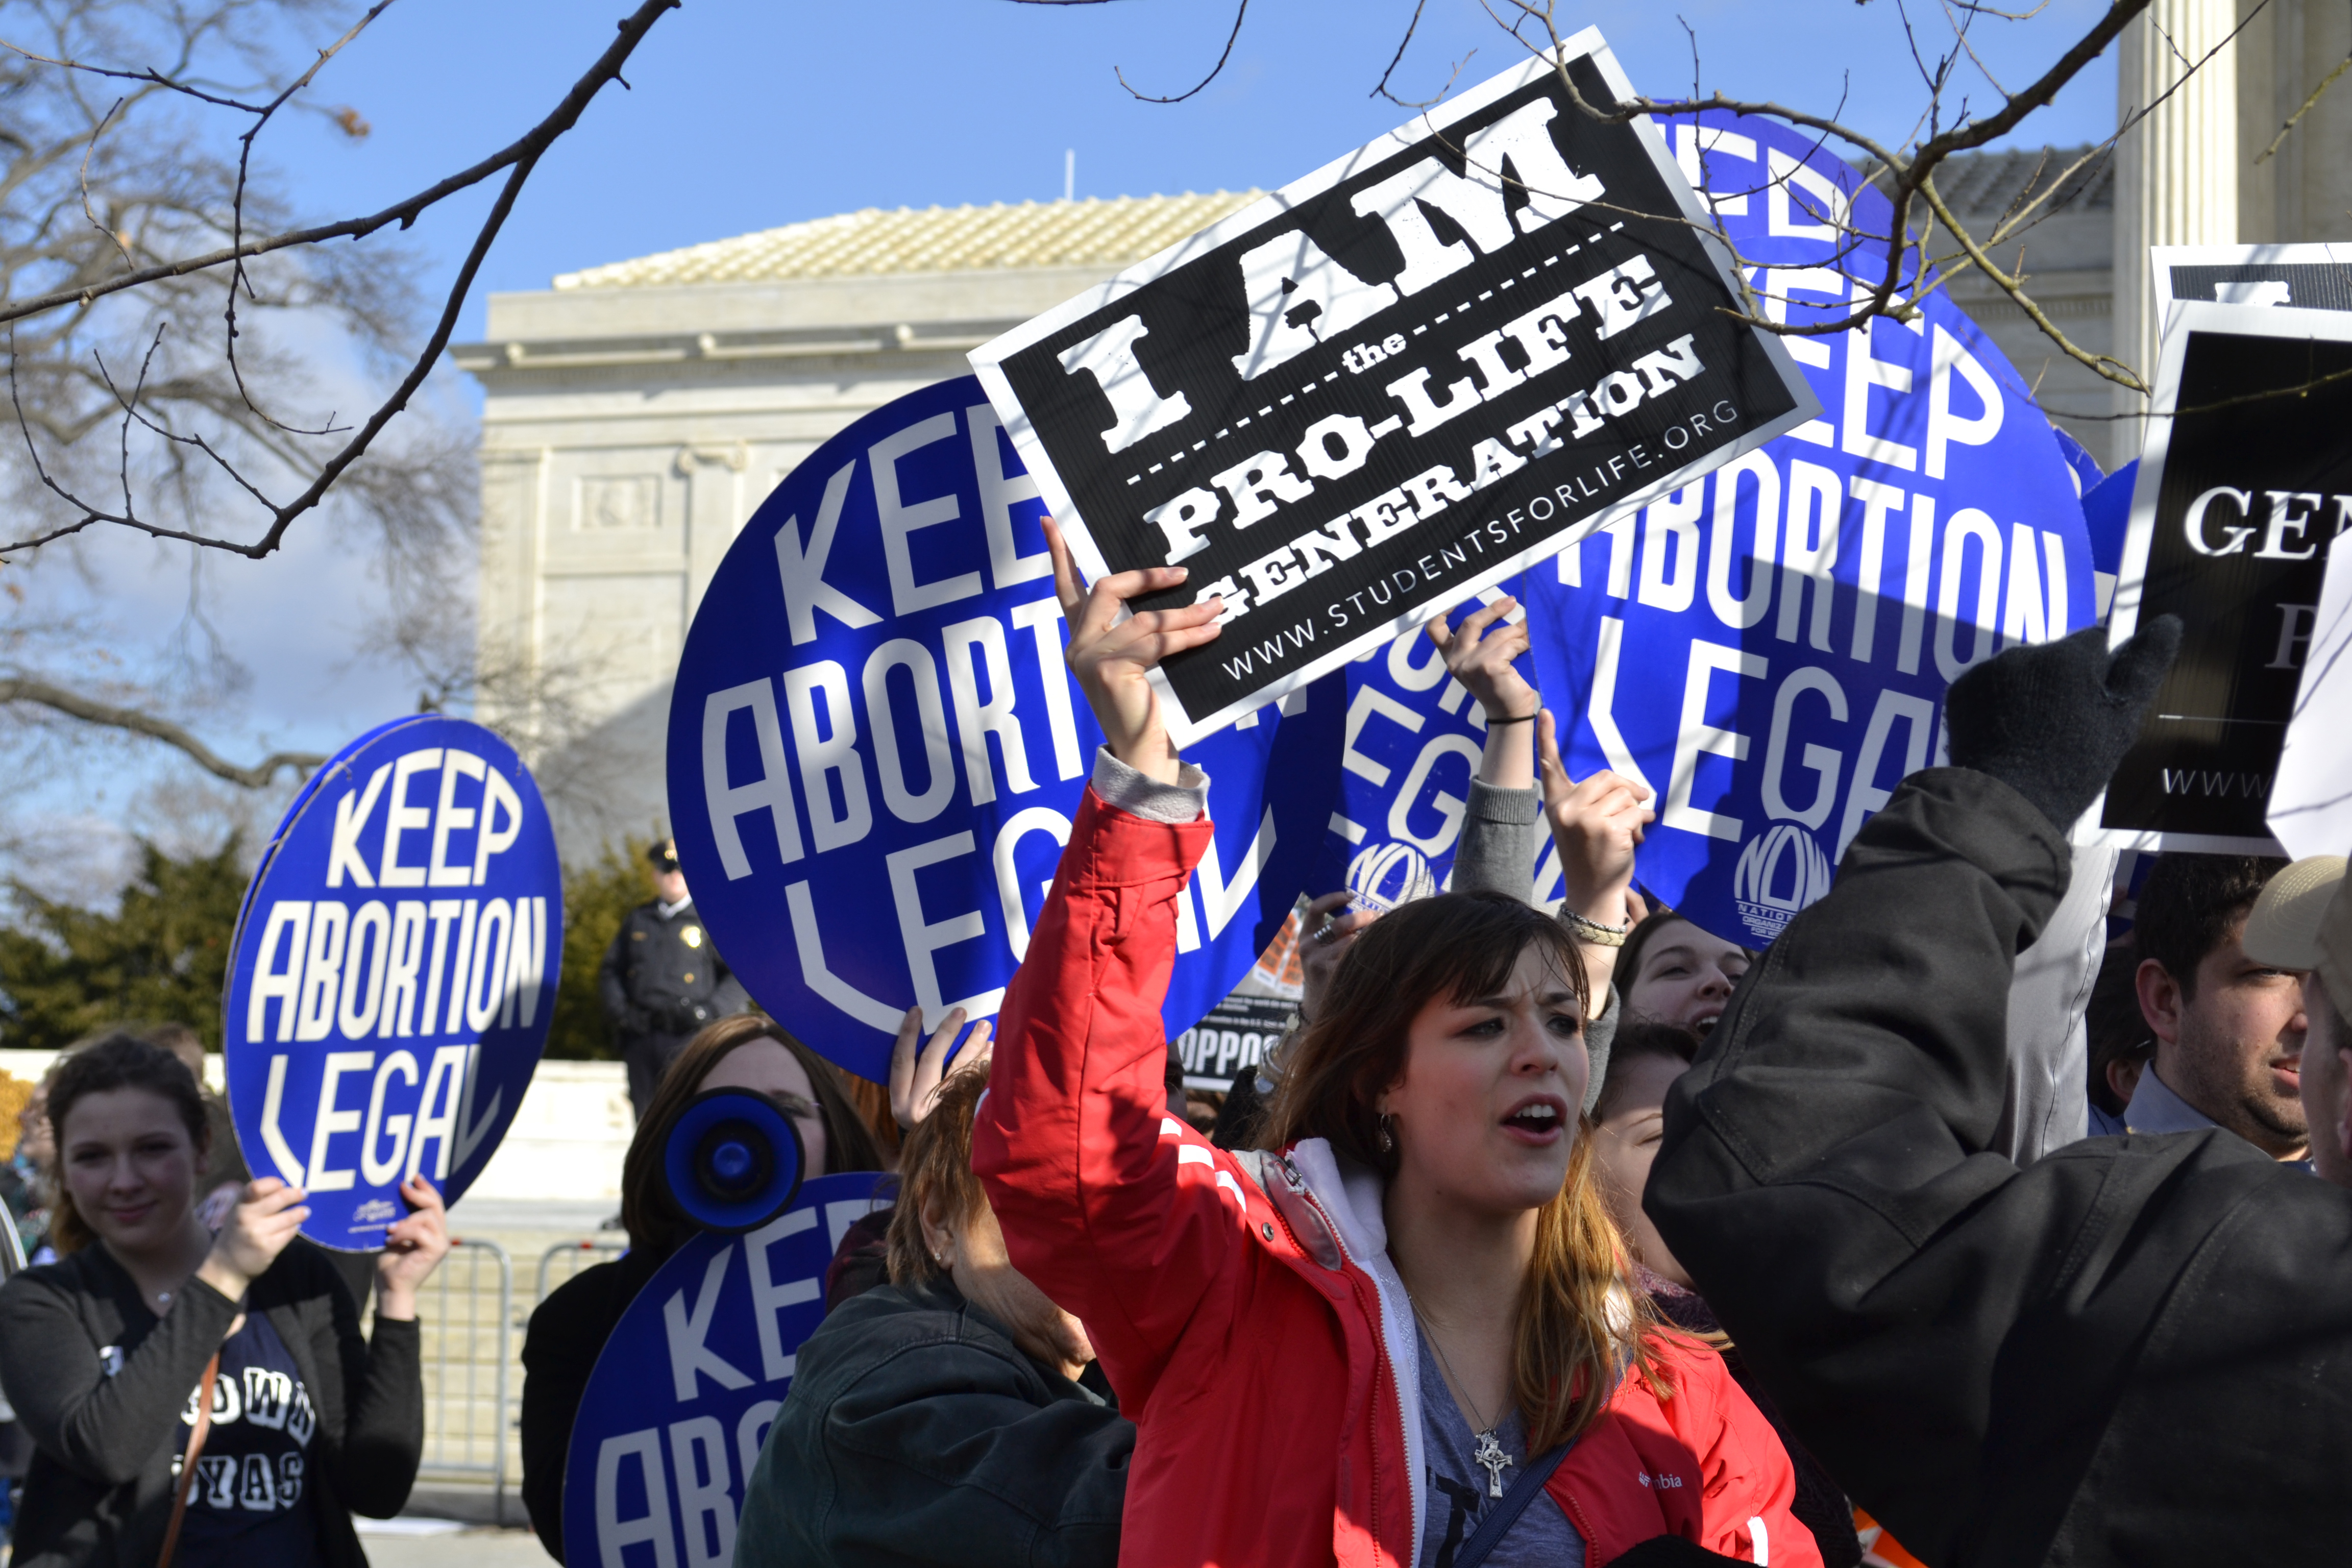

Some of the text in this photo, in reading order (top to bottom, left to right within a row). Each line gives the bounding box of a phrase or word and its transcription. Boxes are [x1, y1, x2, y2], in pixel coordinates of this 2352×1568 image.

[1057, 96, 1606, 454] I AM
[1342, 332, 1407, 375] the
[1743, 263, 2005, 480] EEP
[1143, 255, 1673, 565] PRO-LIFE
[1194, 333, 1705, 624] GENERATION
[774, 402, 1054, 646] KEE
[1221, 400, 1738, 681] WWW.STUDENTSFORLIFE.ORG
[326, 747, 522, 888] KEEP
[1587, 615, 1951, 867] LEGA
[2162, 768, 2273, 798] WWW
[247, 896, 547, 1043] ABORTION
[1177, 1027, 1282, 1075] OPPO
[260, 1043, 503, 1193] LEGAL
